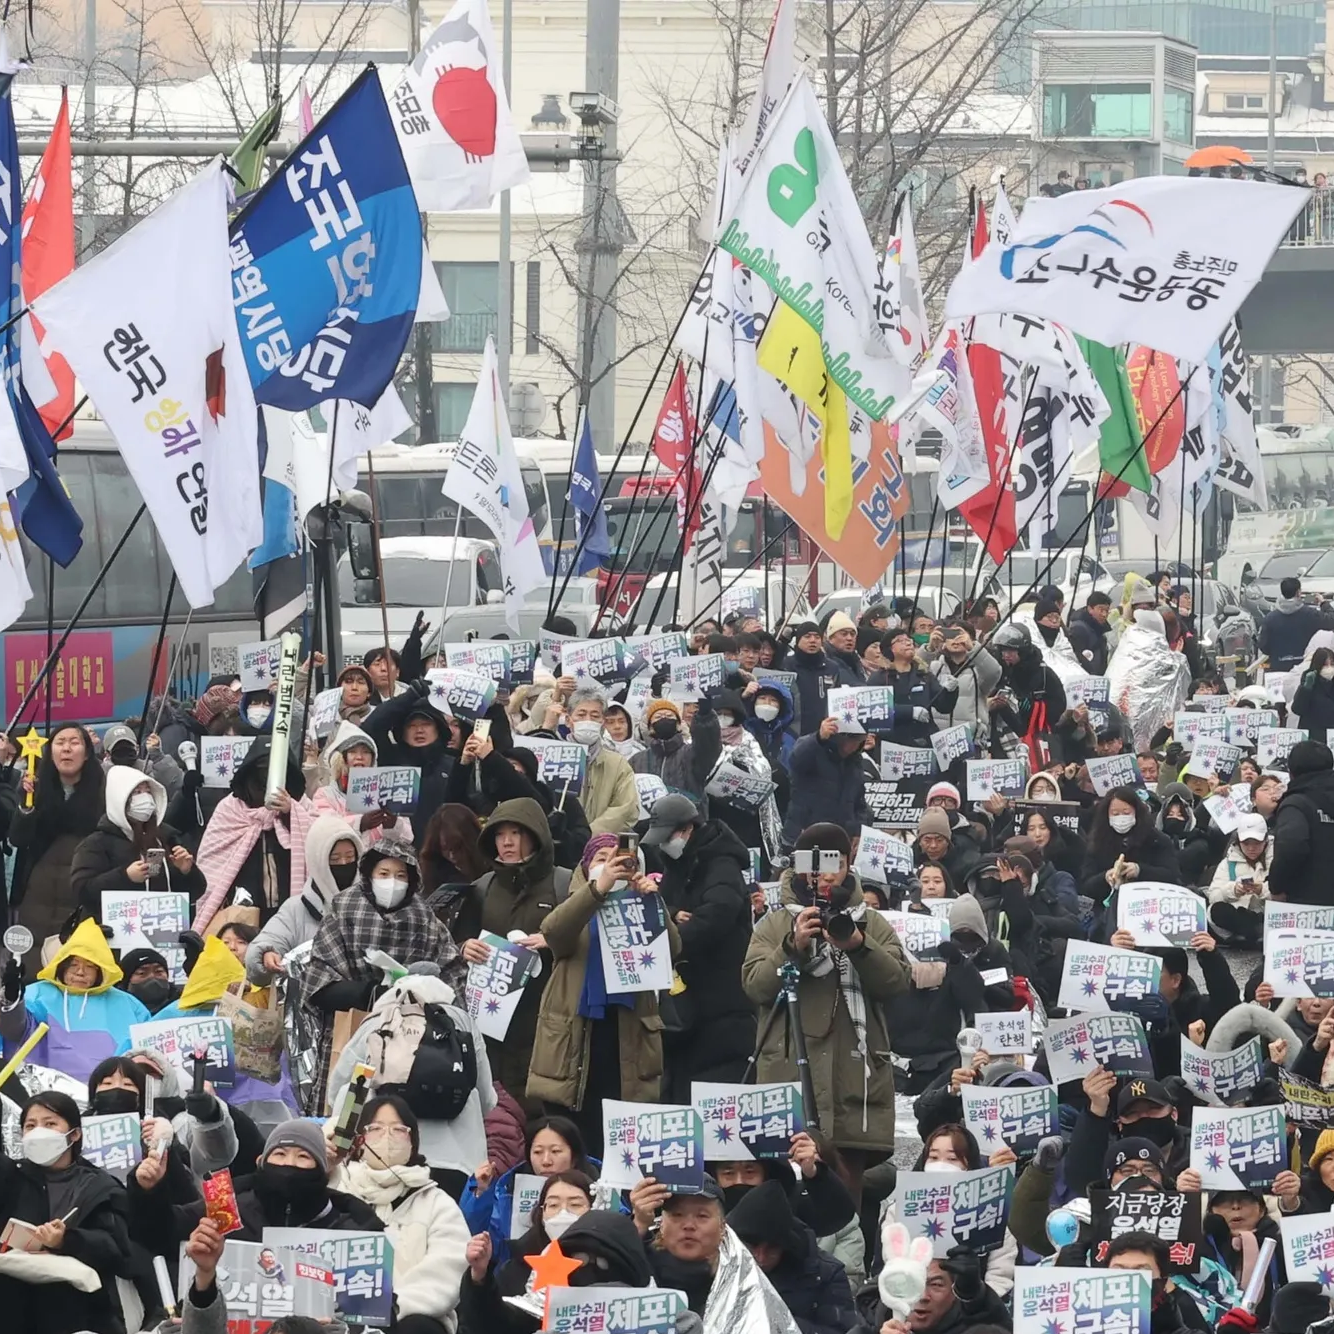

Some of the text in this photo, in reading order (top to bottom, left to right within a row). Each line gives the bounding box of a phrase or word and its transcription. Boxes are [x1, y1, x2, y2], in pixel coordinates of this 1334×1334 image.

[997, 1032, 1027, 1048] 탄핵
[637, 1111, 695, 1141] 체포!
[638, 1141, 695, 1168] 구속!
[905, 1187, 951, 1203] 내란수괴
[1105, 1192, 1187, 1216] 지금당장
[904, 1198, 950, 1217] 윤석열
[556, 1302, 607, 1320] 내란수괴
[608, 1294, 679, 1331] 체포!
[556, 1316, 605, 1334] 윤석열
